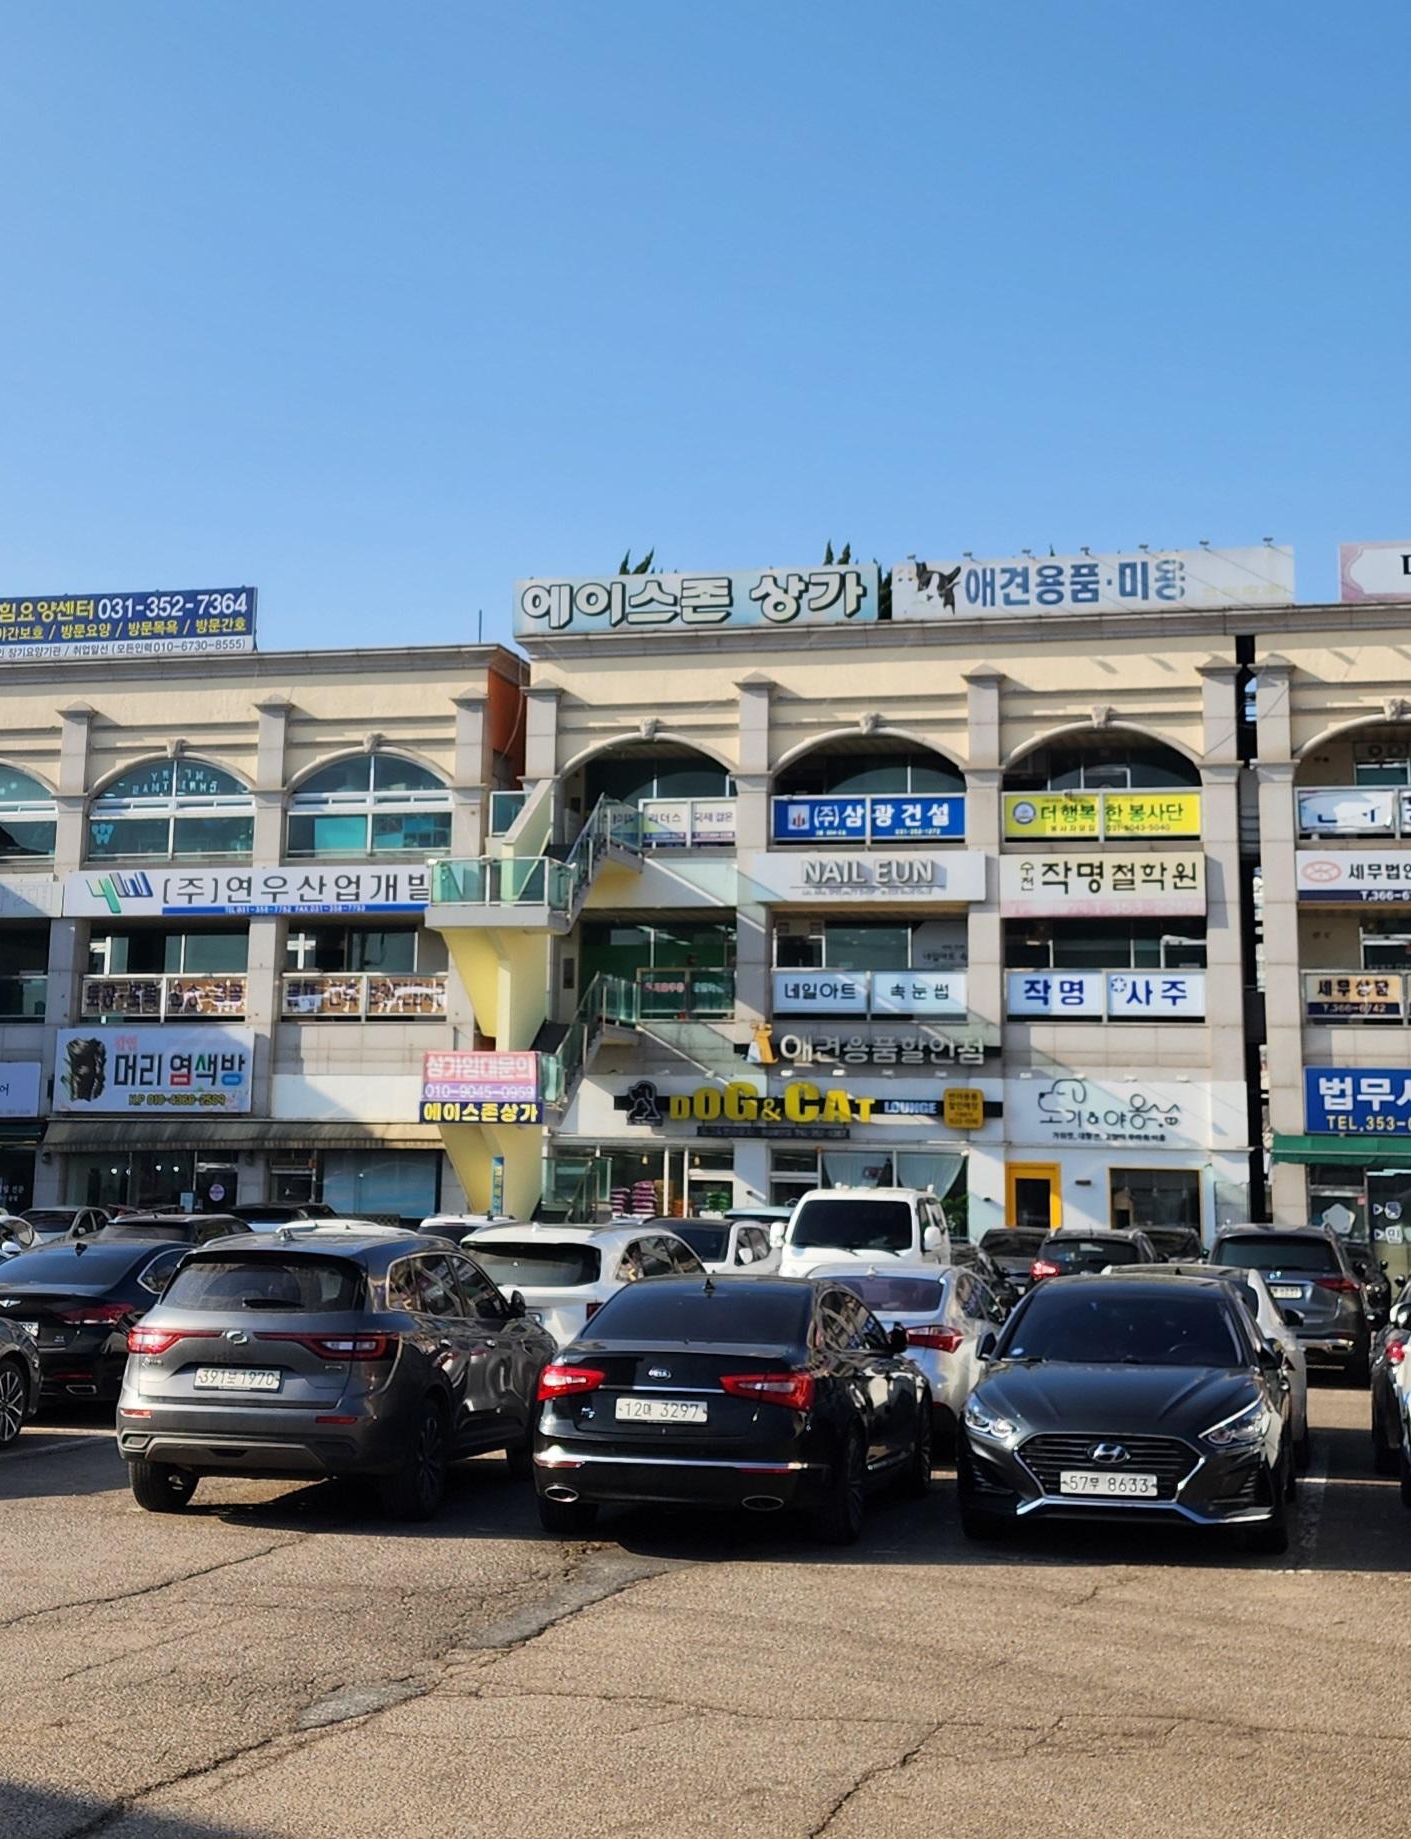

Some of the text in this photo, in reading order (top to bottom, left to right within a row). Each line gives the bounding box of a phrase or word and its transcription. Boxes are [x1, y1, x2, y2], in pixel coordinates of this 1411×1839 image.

[98, 593, 247, 620] 031-352-7364
[521, 571, 868, 629] 에이스존 상가
[61, 623, 111, 639] 방문요양
[196, 617, 247, 633] 방문간호
[802, 859, 935, 885] NAIL EUN
[784, 983, 857, 1000] 네일아트
[891, 983, 950, 1000] 속눈썹
[1024, 979, 1085, 1006] 작명
[1126, 980, 1188, 1006] 사주
[780, 1033, 985, 1065] 애견용품할인점
[114, 1053, 246, 1087] 머리 염색방
[427, 1056, 530, 1079] 상가임대문의
[423, 1102, 539, 1122] 에이스존상가
[884, 1101, 937, 1114] LOUNGE
[1326, 1114, 1411, 1132] TEL.353-
[660, 1402, 700, 1419] 3297
[1108, 1477, 1149, 1493] 8633
